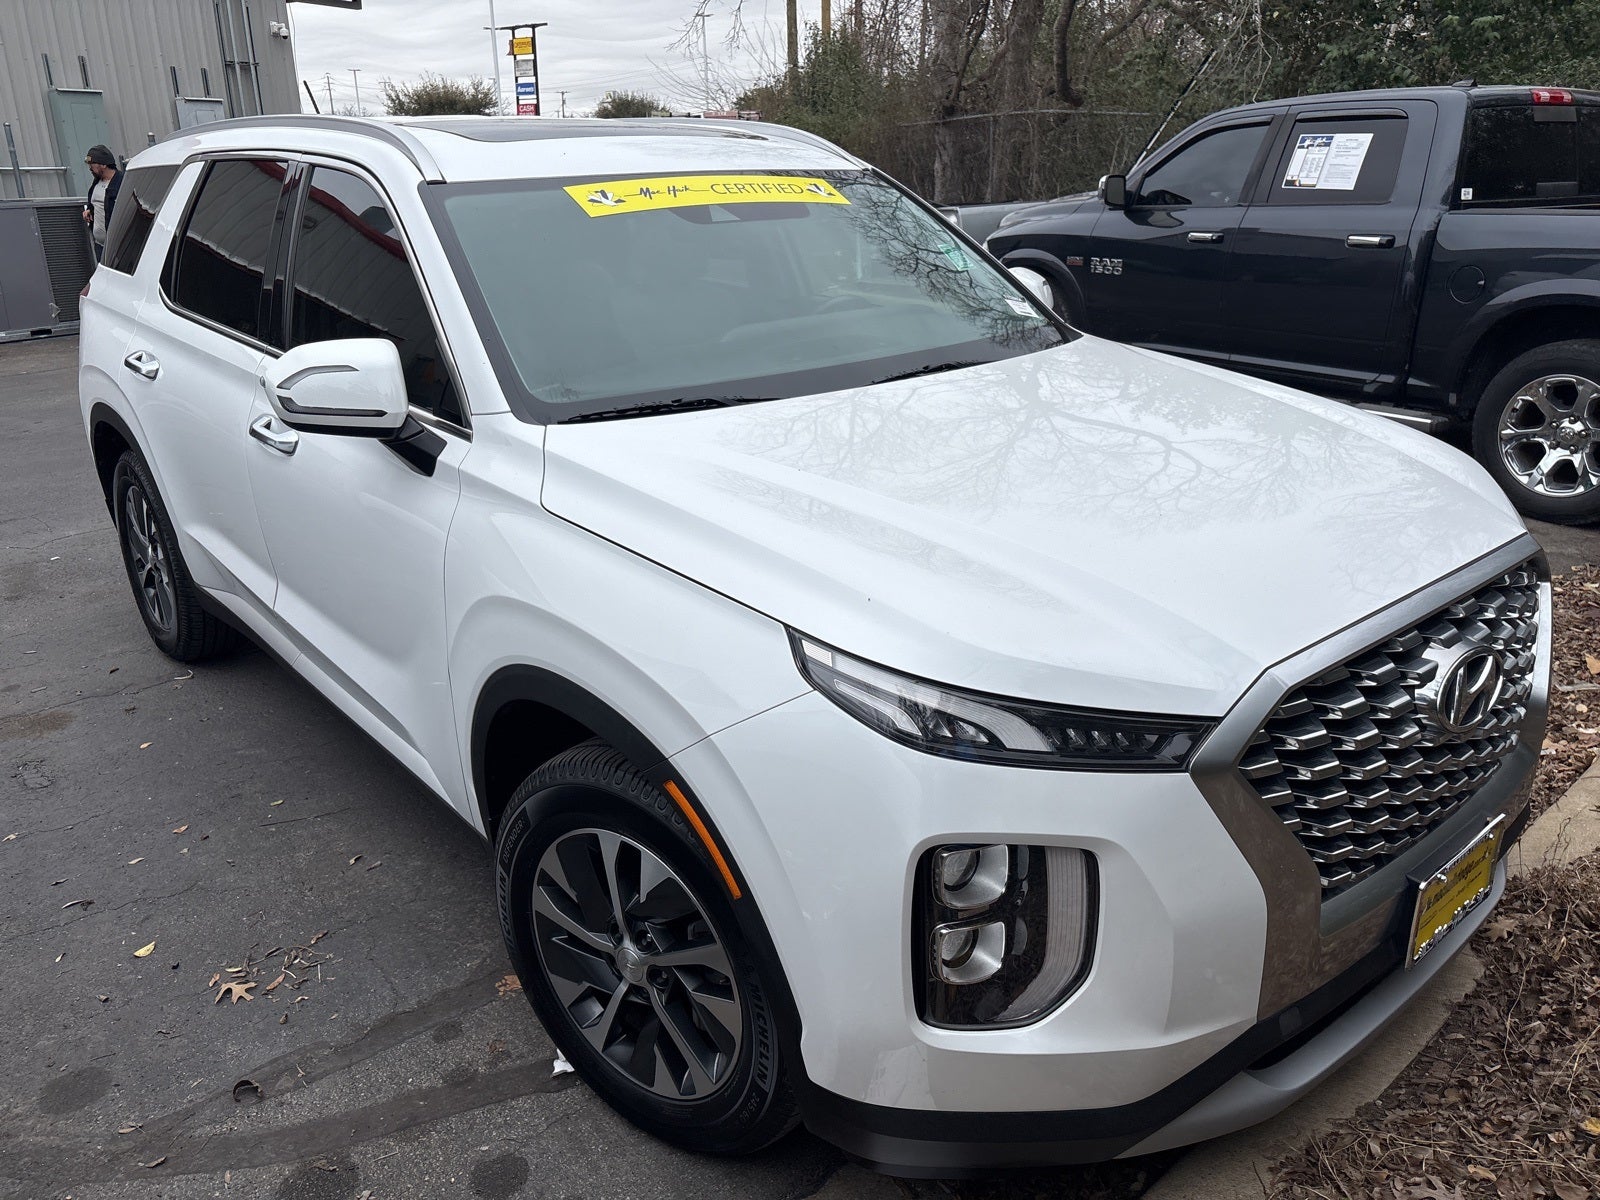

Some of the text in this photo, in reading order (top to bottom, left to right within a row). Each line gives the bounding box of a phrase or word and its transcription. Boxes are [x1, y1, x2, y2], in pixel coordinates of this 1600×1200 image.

[637, 182, 805, 200] Mac Haik CERTIFIED
[1090, 257, 1123, 267] RAM
[1090, 265, 1123, 275] 1500
[750, 983, 770, 1086] MICHELIN
